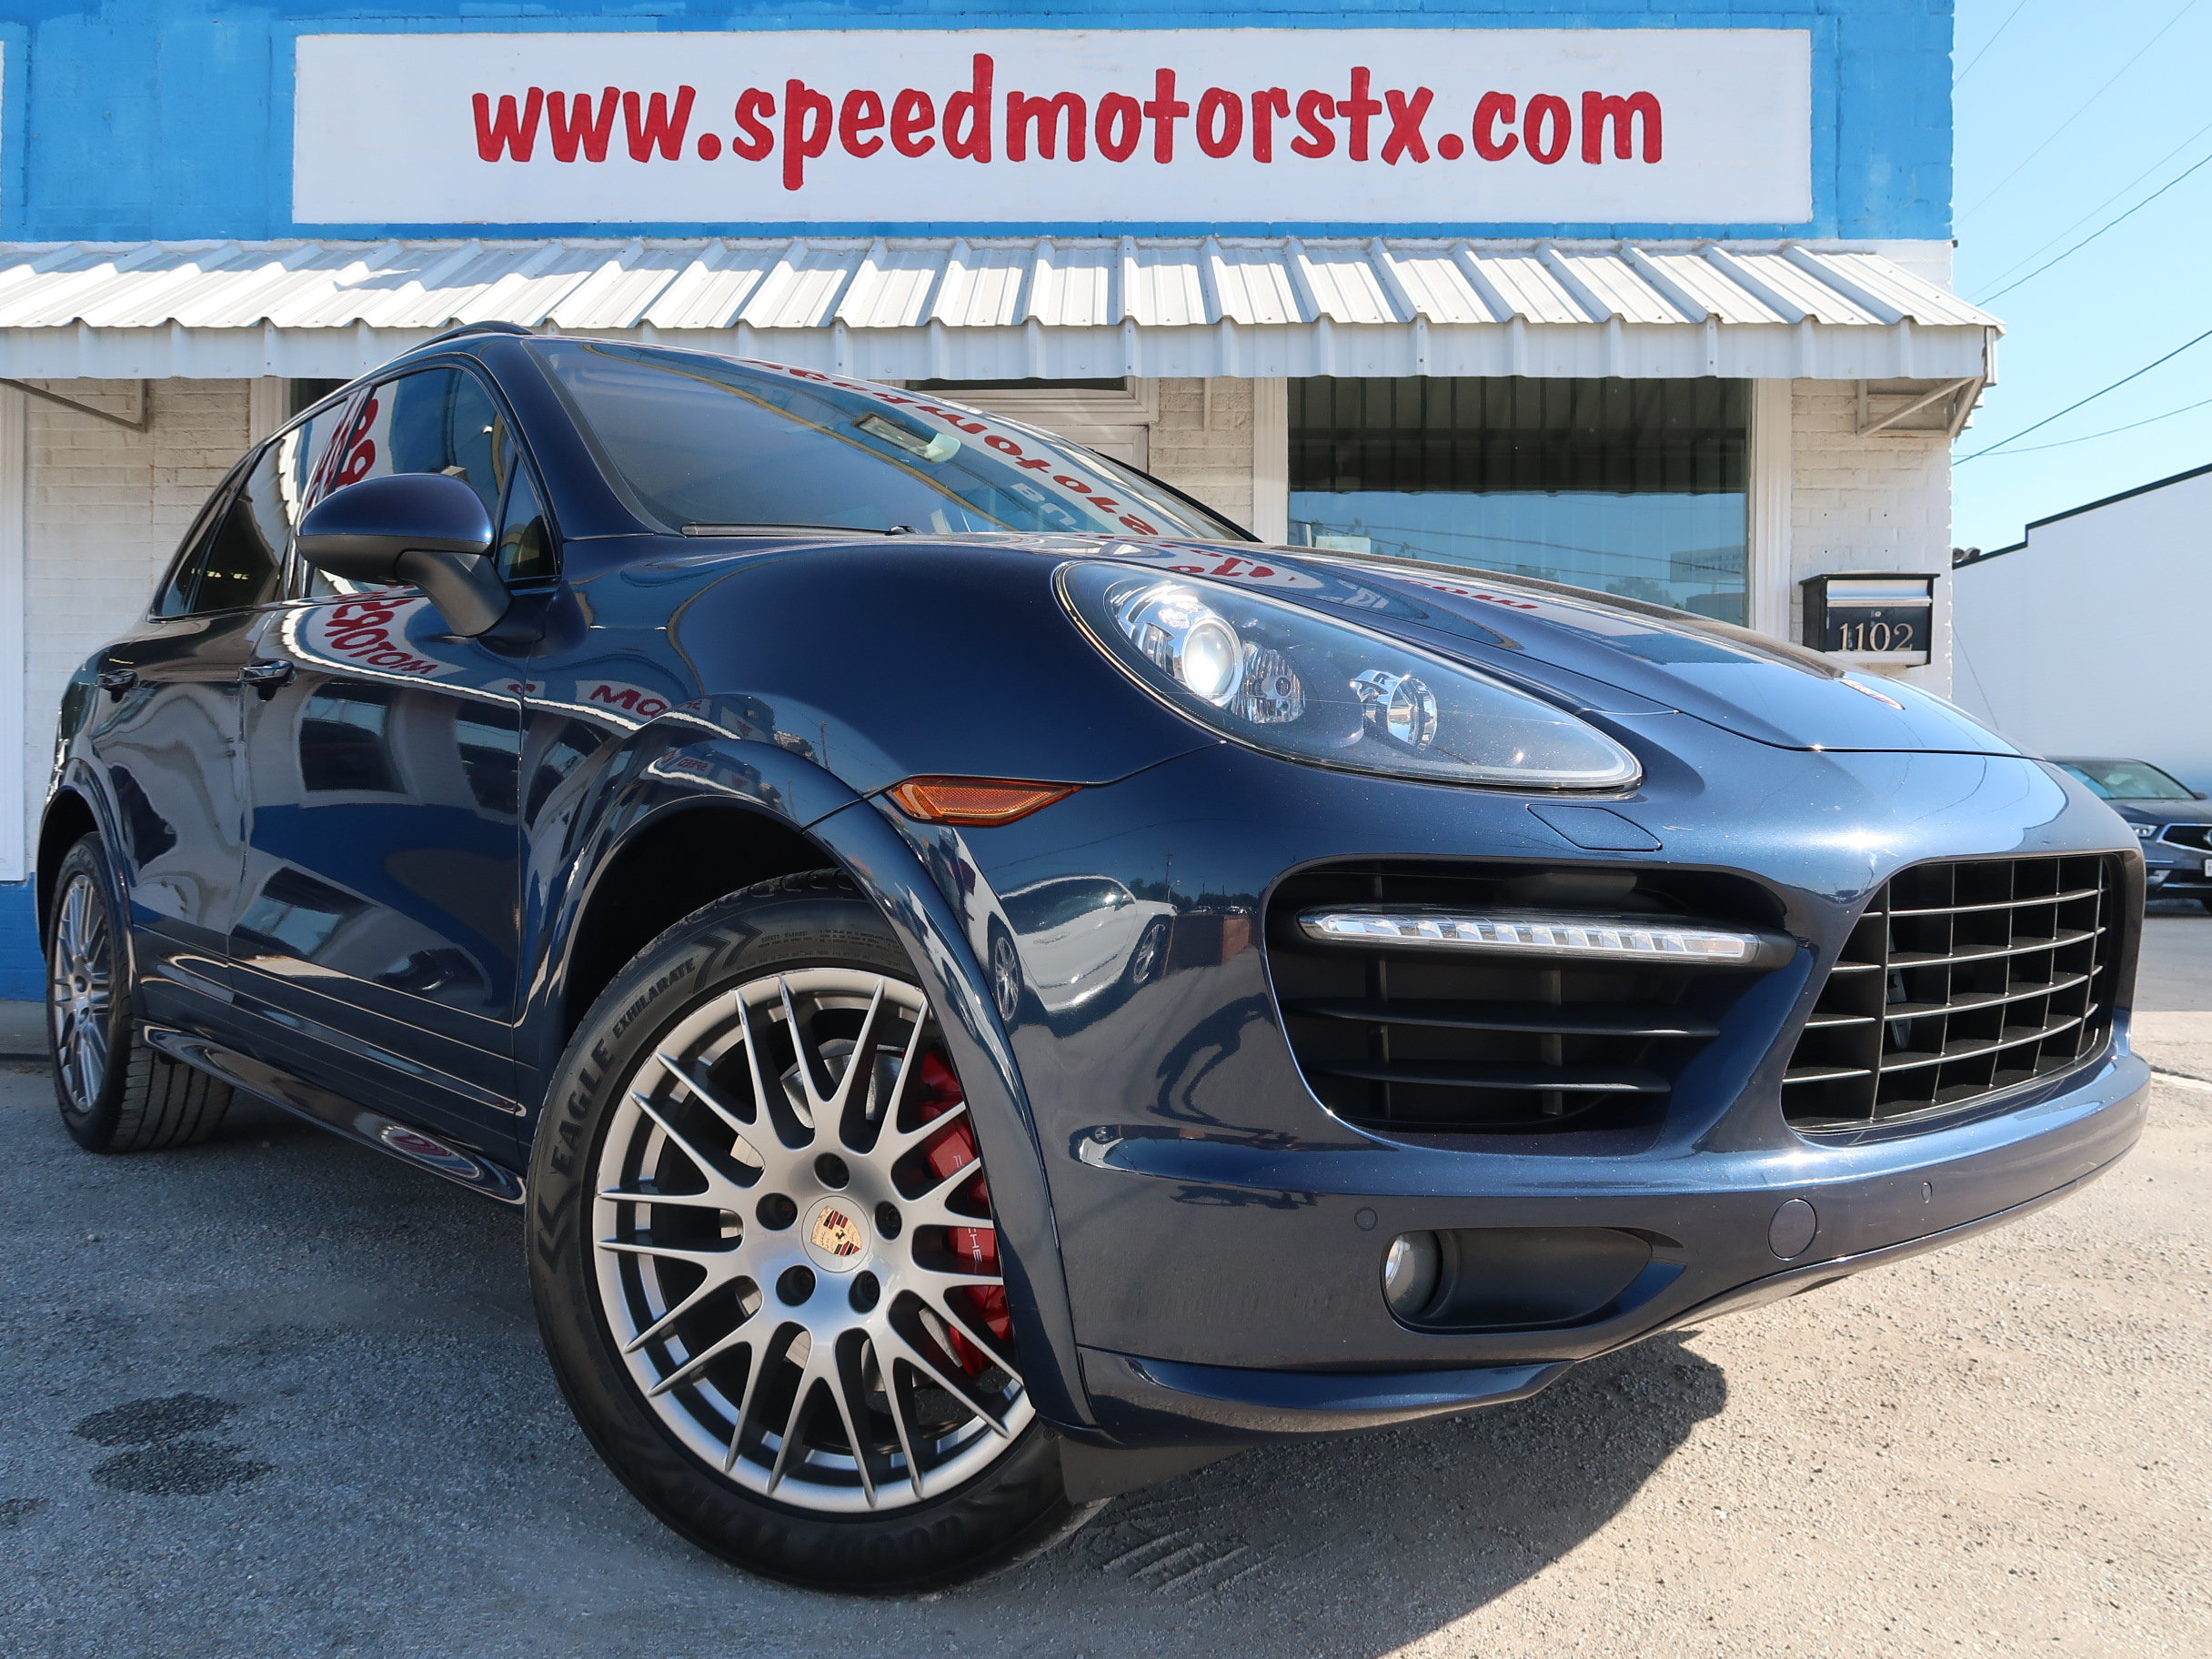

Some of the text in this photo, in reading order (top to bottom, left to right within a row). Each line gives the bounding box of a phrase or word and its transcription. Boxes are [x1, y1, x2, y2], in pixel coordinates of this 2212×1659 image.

[473, 54, 1664, 189] www.speedmotorstx.com
[1839, 622, 1914, 652] 1102
[549, 957, 699, 1175] EAGLE EXHILARATE
